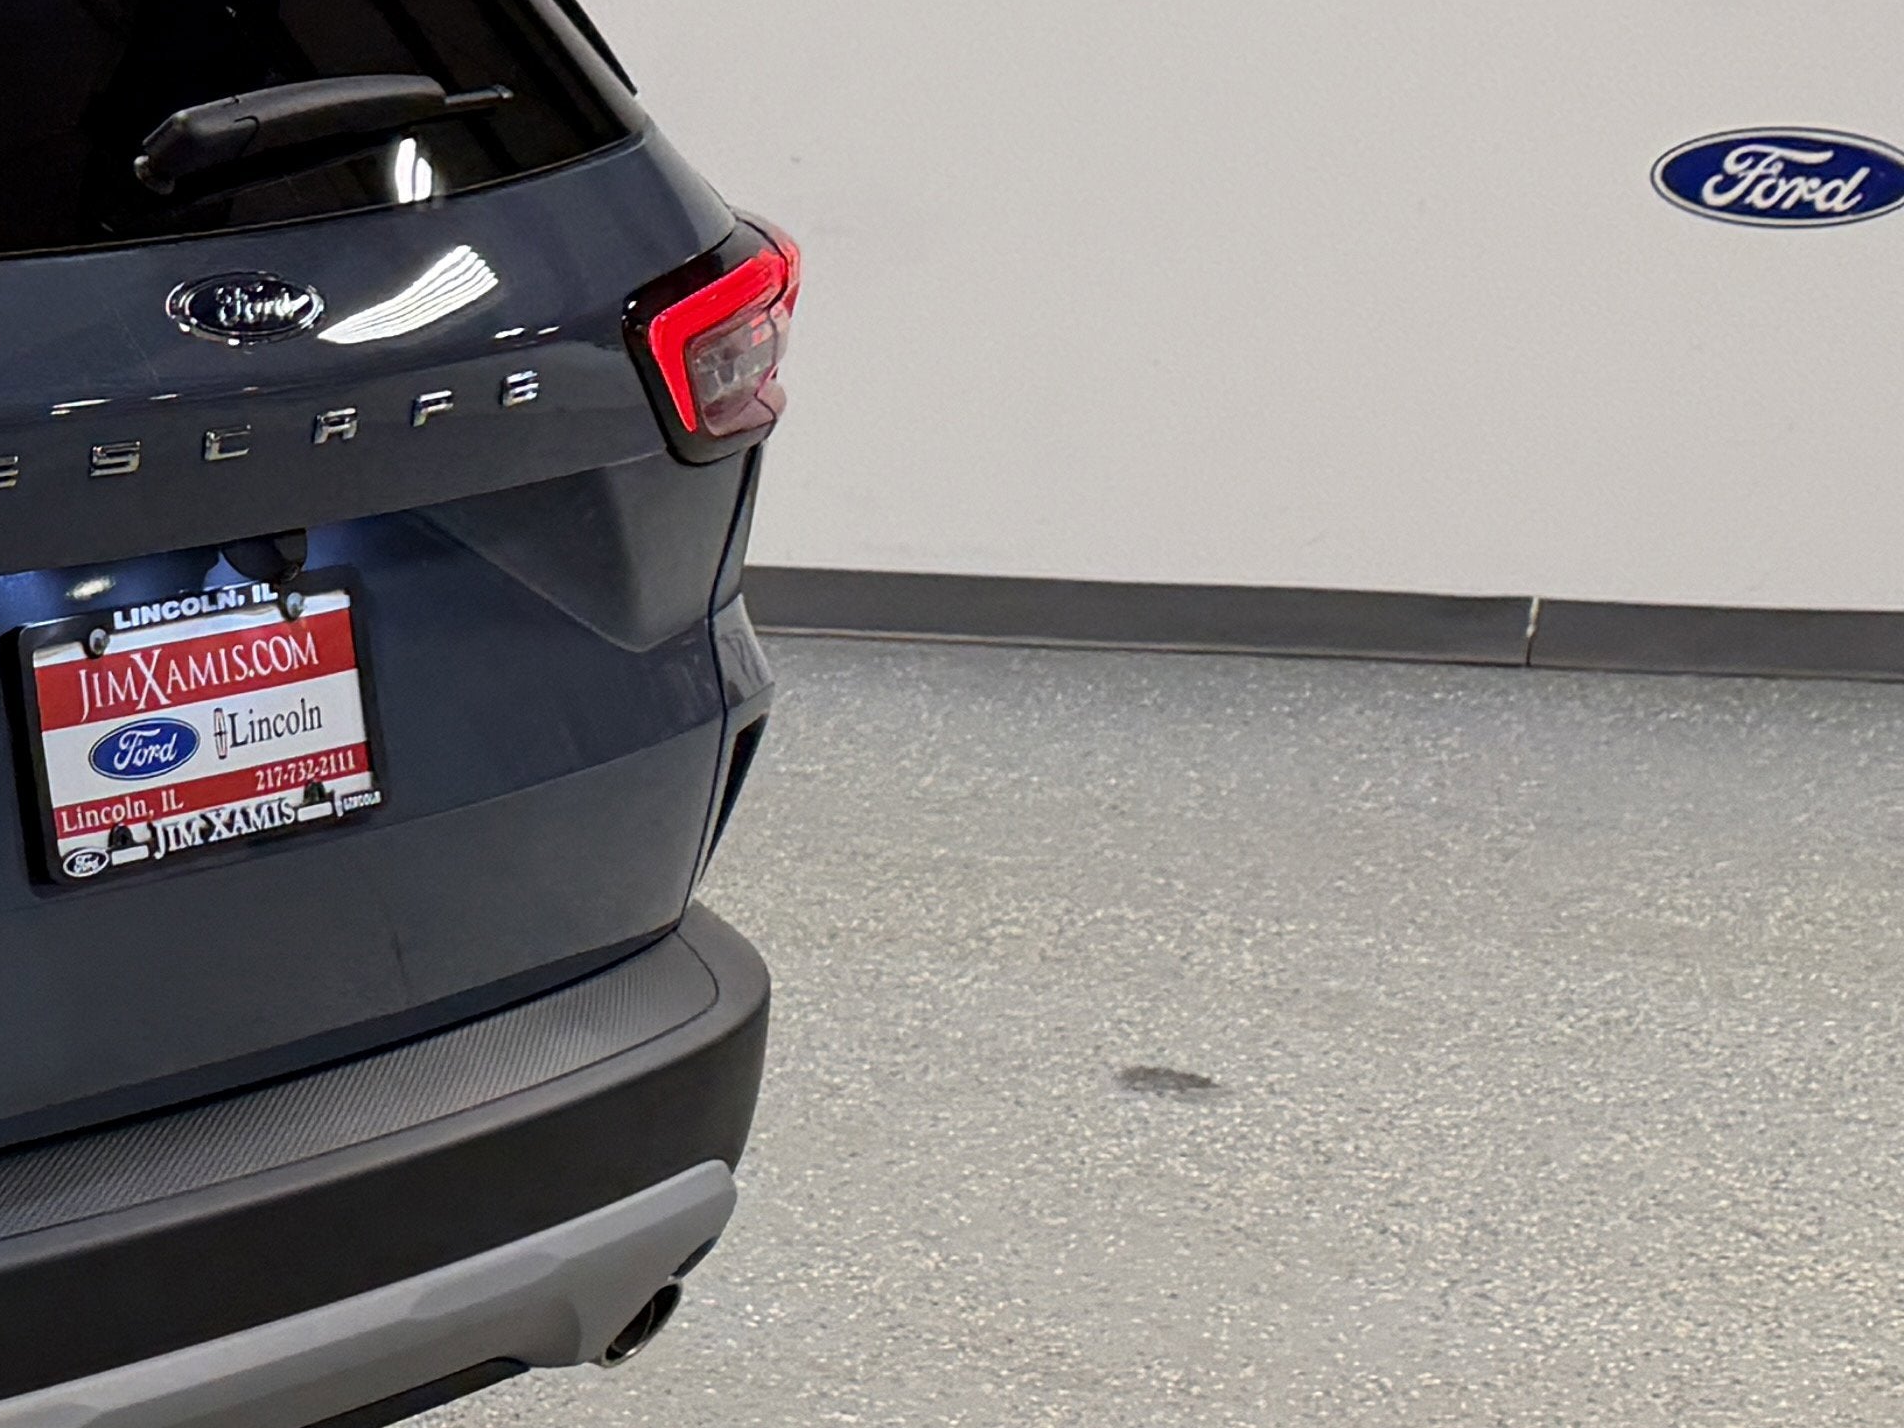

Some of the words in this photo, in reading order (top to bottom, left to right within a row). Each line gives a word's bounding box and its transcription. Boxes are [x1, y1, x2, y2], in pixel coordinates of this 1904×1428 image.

[1702, 144, 1871, 212] Ford
[114, 589, 245, 630] LINCOLN,
[253, 583, 278, 603] IL
[229, 698, 322, 748] Lincoln
[114, 728, 179, 771] Ford
[60, 795, 154, 833] Lincoln,
[161, 789, 184, 811] IL
